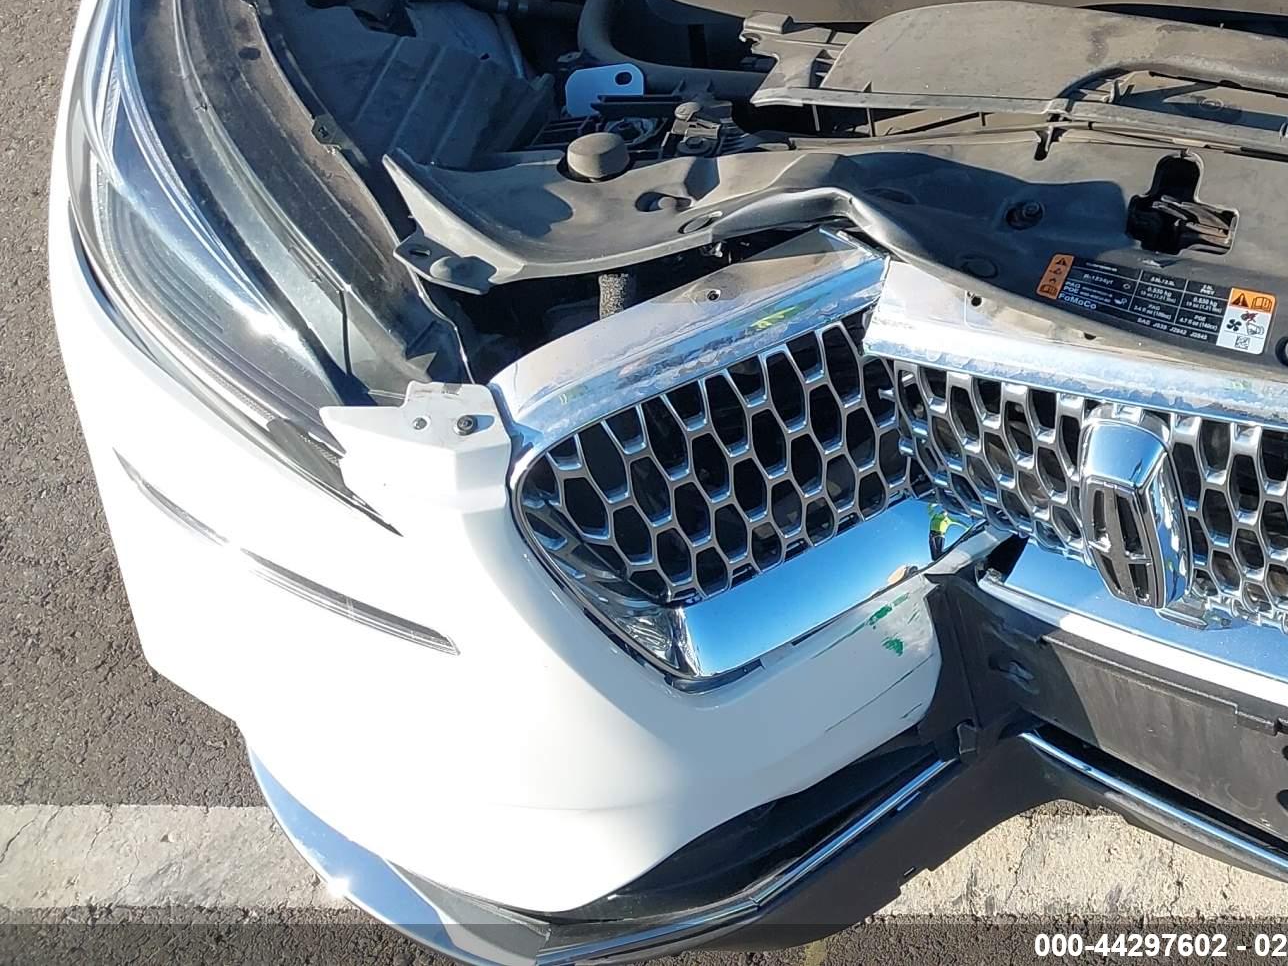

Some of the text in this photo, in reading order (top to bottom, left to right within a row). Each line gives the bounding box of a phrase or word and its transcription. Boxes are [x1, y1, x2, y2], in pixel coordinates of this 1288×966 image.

[1063, 285, 1080, 294] POE
[1065, 281, 1081, 289] PAG
[1058, 293, 1097, 309] FoMoCo
